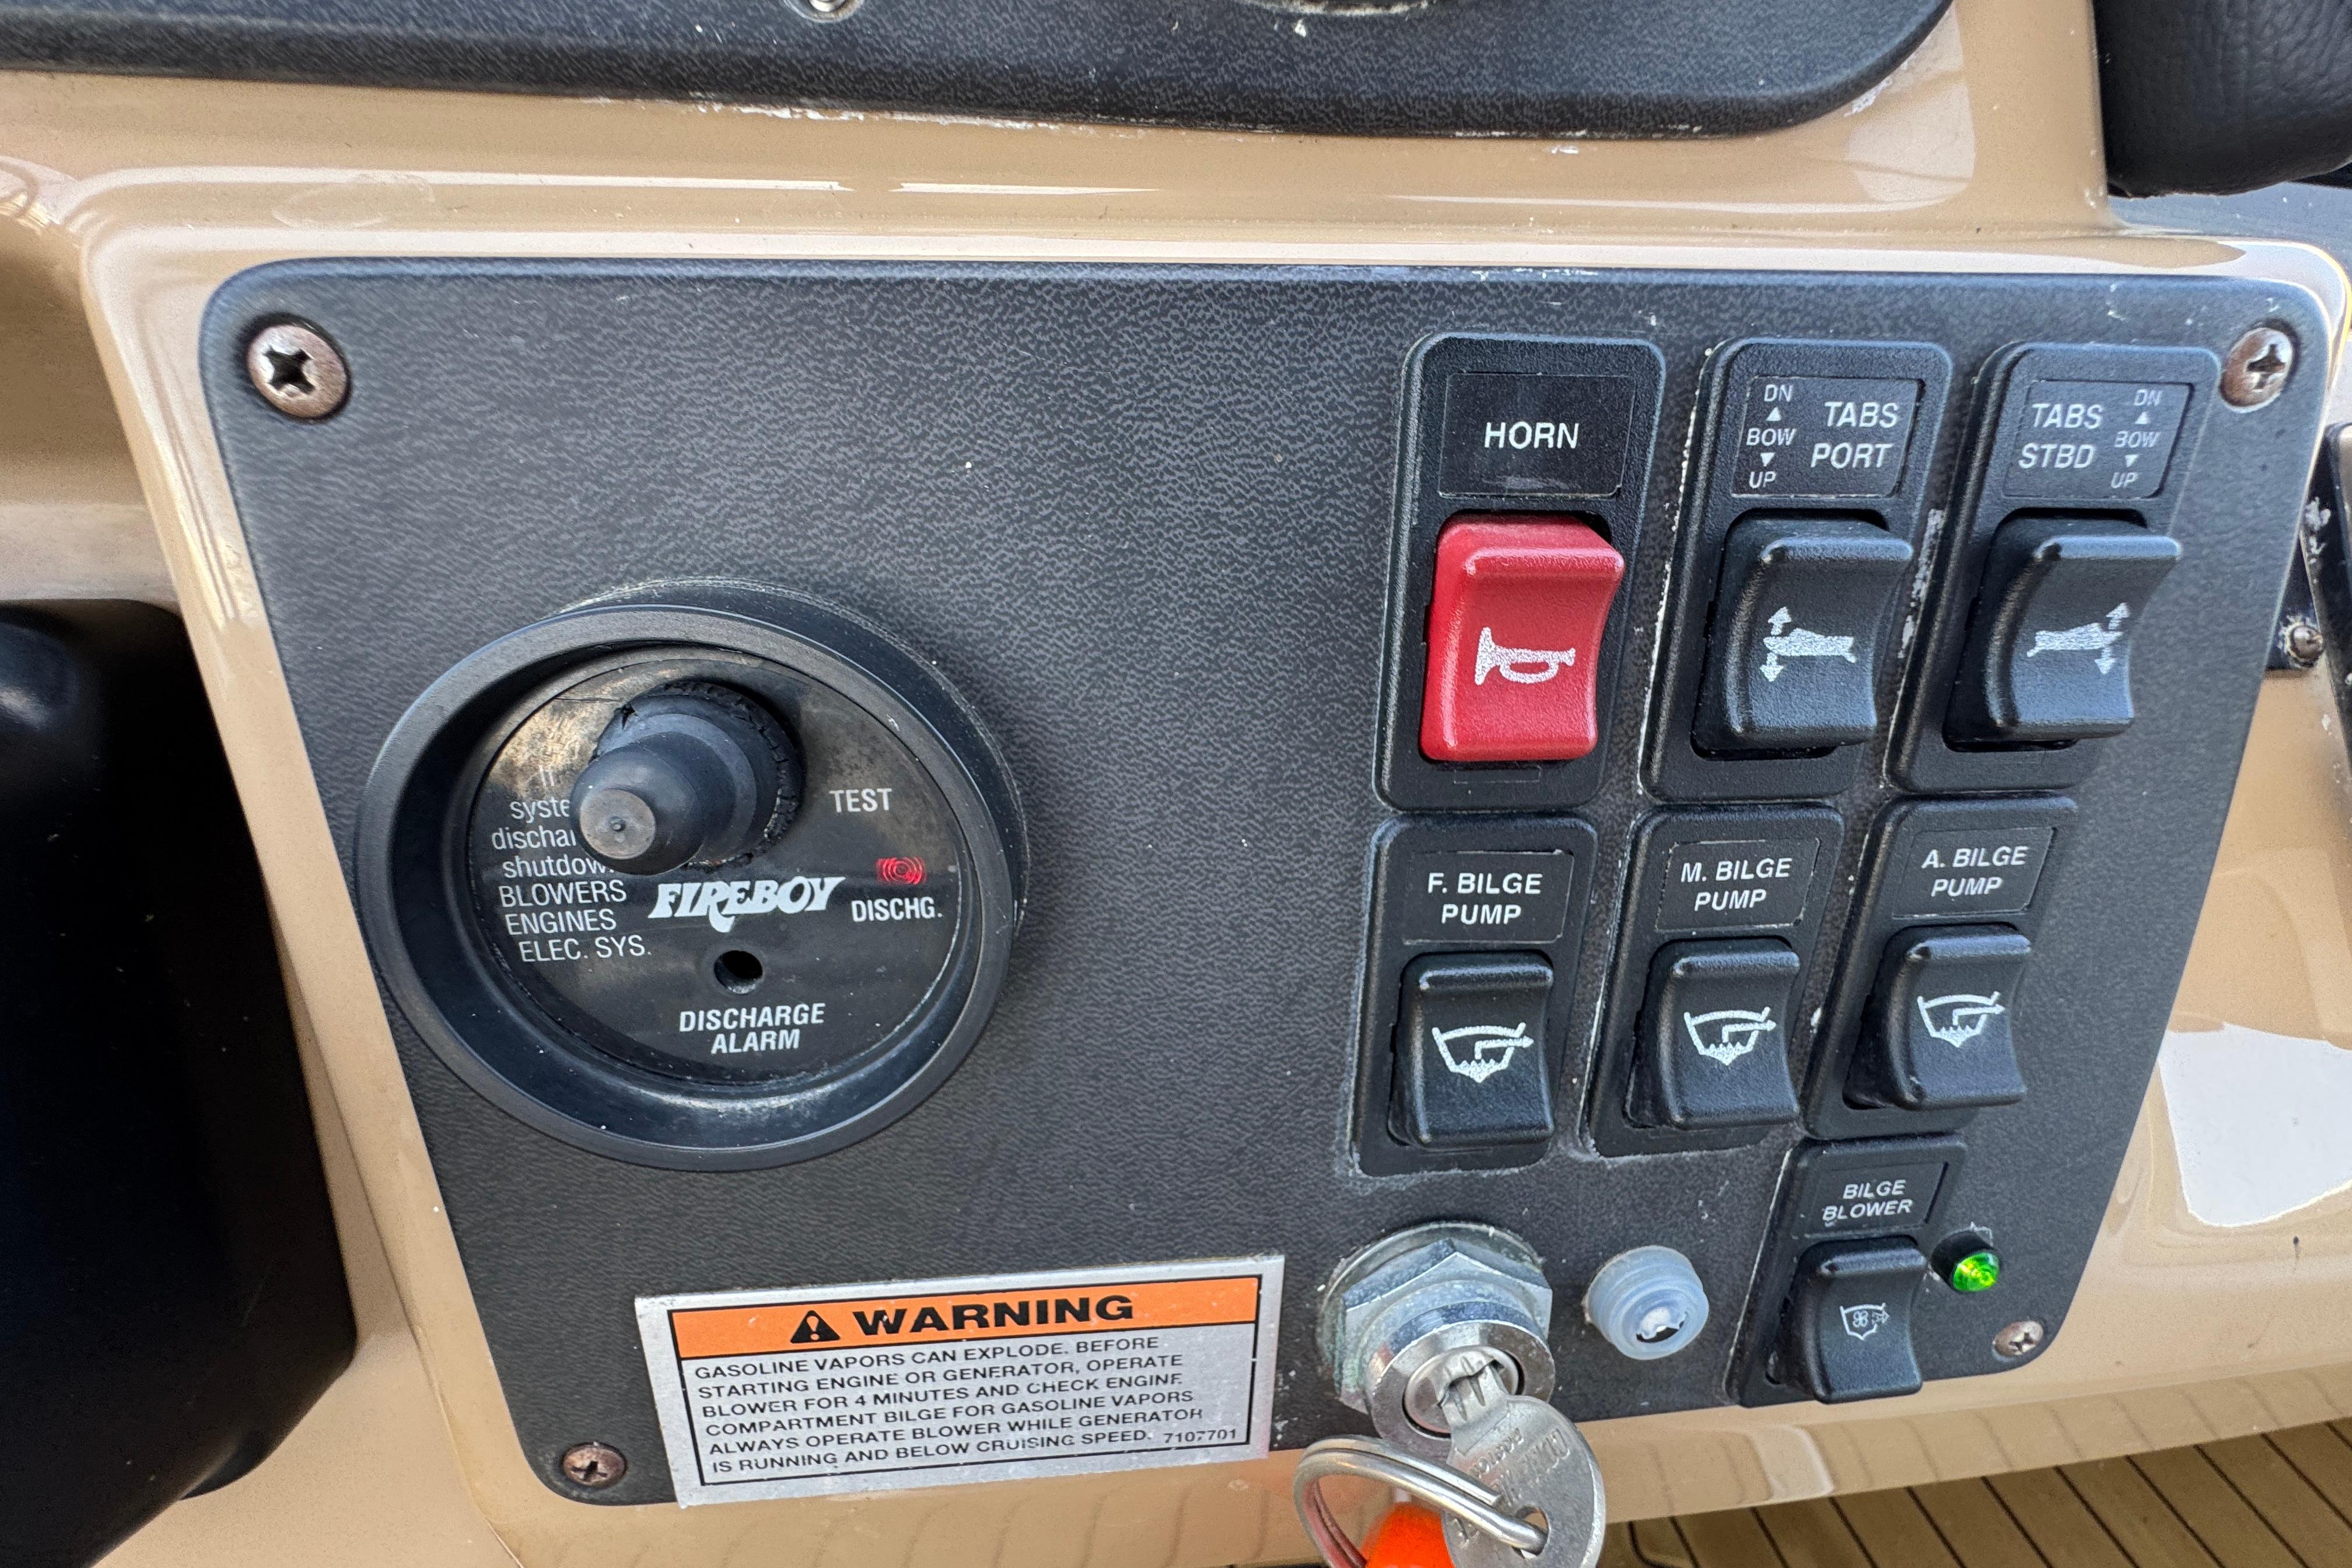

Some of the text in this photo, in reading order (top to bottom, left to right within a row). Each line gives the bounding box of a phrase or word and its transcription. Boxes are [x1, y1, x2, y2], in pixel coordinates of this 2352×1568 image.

[1764, 384, 1794, 402] DN
[2133, 388, 2163, 407] DN
[1824, 401, 1899, 429] TABS
[2031, 402, 2105, 430] TABS
[1483, 421, 1580, 450] HORN
[1746, 427, 1797, 447] BOW
[2113, 430, 2161, 449] BOW
[1810, 442, 1895, 470] PORT
[2018, 442, 2097, 470] STBD
[1748, 471, 1777, 489] UP
[2109, 471, 2140, 489] UP
[509, 796, 570, 824] syste
[829, 788, 892, 814] TEST
[502, 853, 615, 878] shutdow
[1681, 858, 1793, 883] M. BILGE
[1921, 845, 2030, 869] A. BILGE
[498, 879, 627, 908] BLOWERS
[1428, 872, 1544, 895] F. BILGE
[1931, 876, 2003, 898] PUMP
[648, 876, 846, 933] FIREBOY
[851, 897, 943, 923] DISCHG.
[1694, 888, 1767, 912] PUMP
[505, 908, 617, 936] ENGINES
[1441, 904, 1522, 925] PUMP
[518, 934, 652, 963] ELEC. SYS.
[678, 1003, 825, 1032] DISCHARGE
[710, 1028, 801, 1055] ALARM
[1842, 1178, 1907, 1200] BILGE
[1822, 1198, 1913, 1223] BLOWER
[852, 1295, 1135, 1336] WARNING
[695, 1360, 809, 1379] GASOLINE
[814, 1353, 905, 1371] VAPORS
[911, 1350, 957, 1364] CAN
[1076, 1337, 1159, 1353] BEFORE
[699, 1354, 1183, 1399] STARTING ENGINE OR GENERATOR, OPERATE
[702, 1373, 1183, 1418] BLOWER FOR 4 MINUTES AND CHECK ENGINE
[706, 1391, 1194, 1437] COMPARTMENT BILGE FOR GASOLINE VAPORS
[709, 1408, 1203, 1455] ALWAYS OPERATE BLOWER WHILE GENERATOR
[713, 1461, 733, 1473] IS
[740, 1453, 838, 1471] RUNNING
[845, 1448, 889, 1462] AND
[896, 1443, 970, 1458] BELOW
[976, 1435, 1075, 1452] CRUISING
[1080, 1430, 1153, 1445] SPEED.
